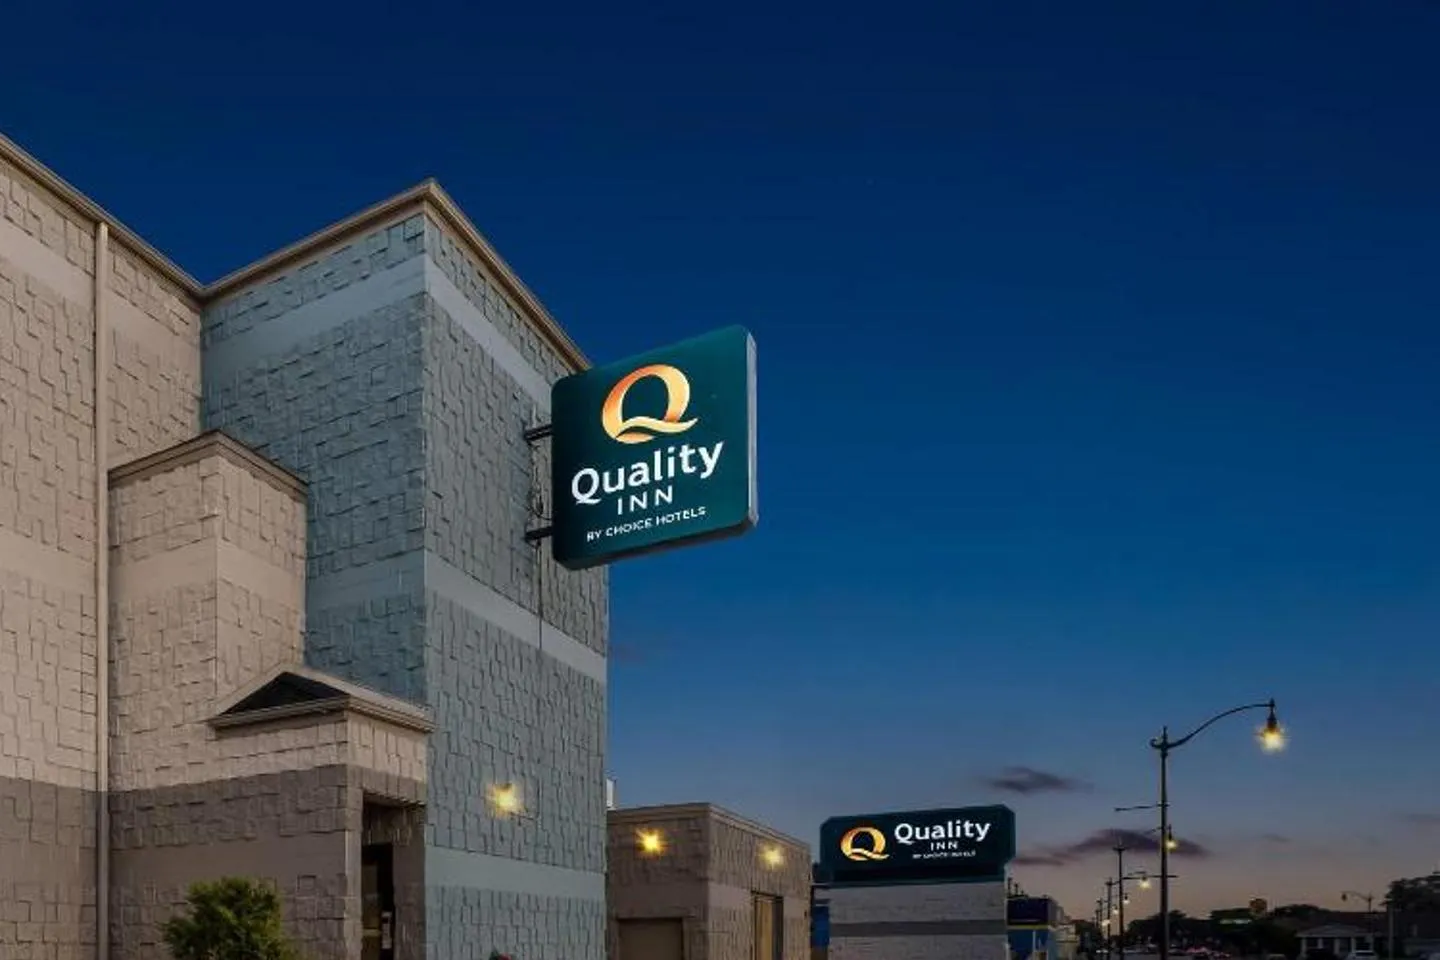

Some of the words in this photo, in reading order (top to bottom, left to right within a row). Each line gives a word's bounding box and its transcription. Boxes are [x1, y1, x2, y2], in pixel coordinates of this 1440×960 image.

[571, 440, 725, 505] Quality
[617, 486, 673, 515] INN
[605, 518, 653, 537] CHOICE
[656, 506, 707, 526] HOTELS
[894, 819, 991, 845] Quality
[930, 841, 959, 851] INN
